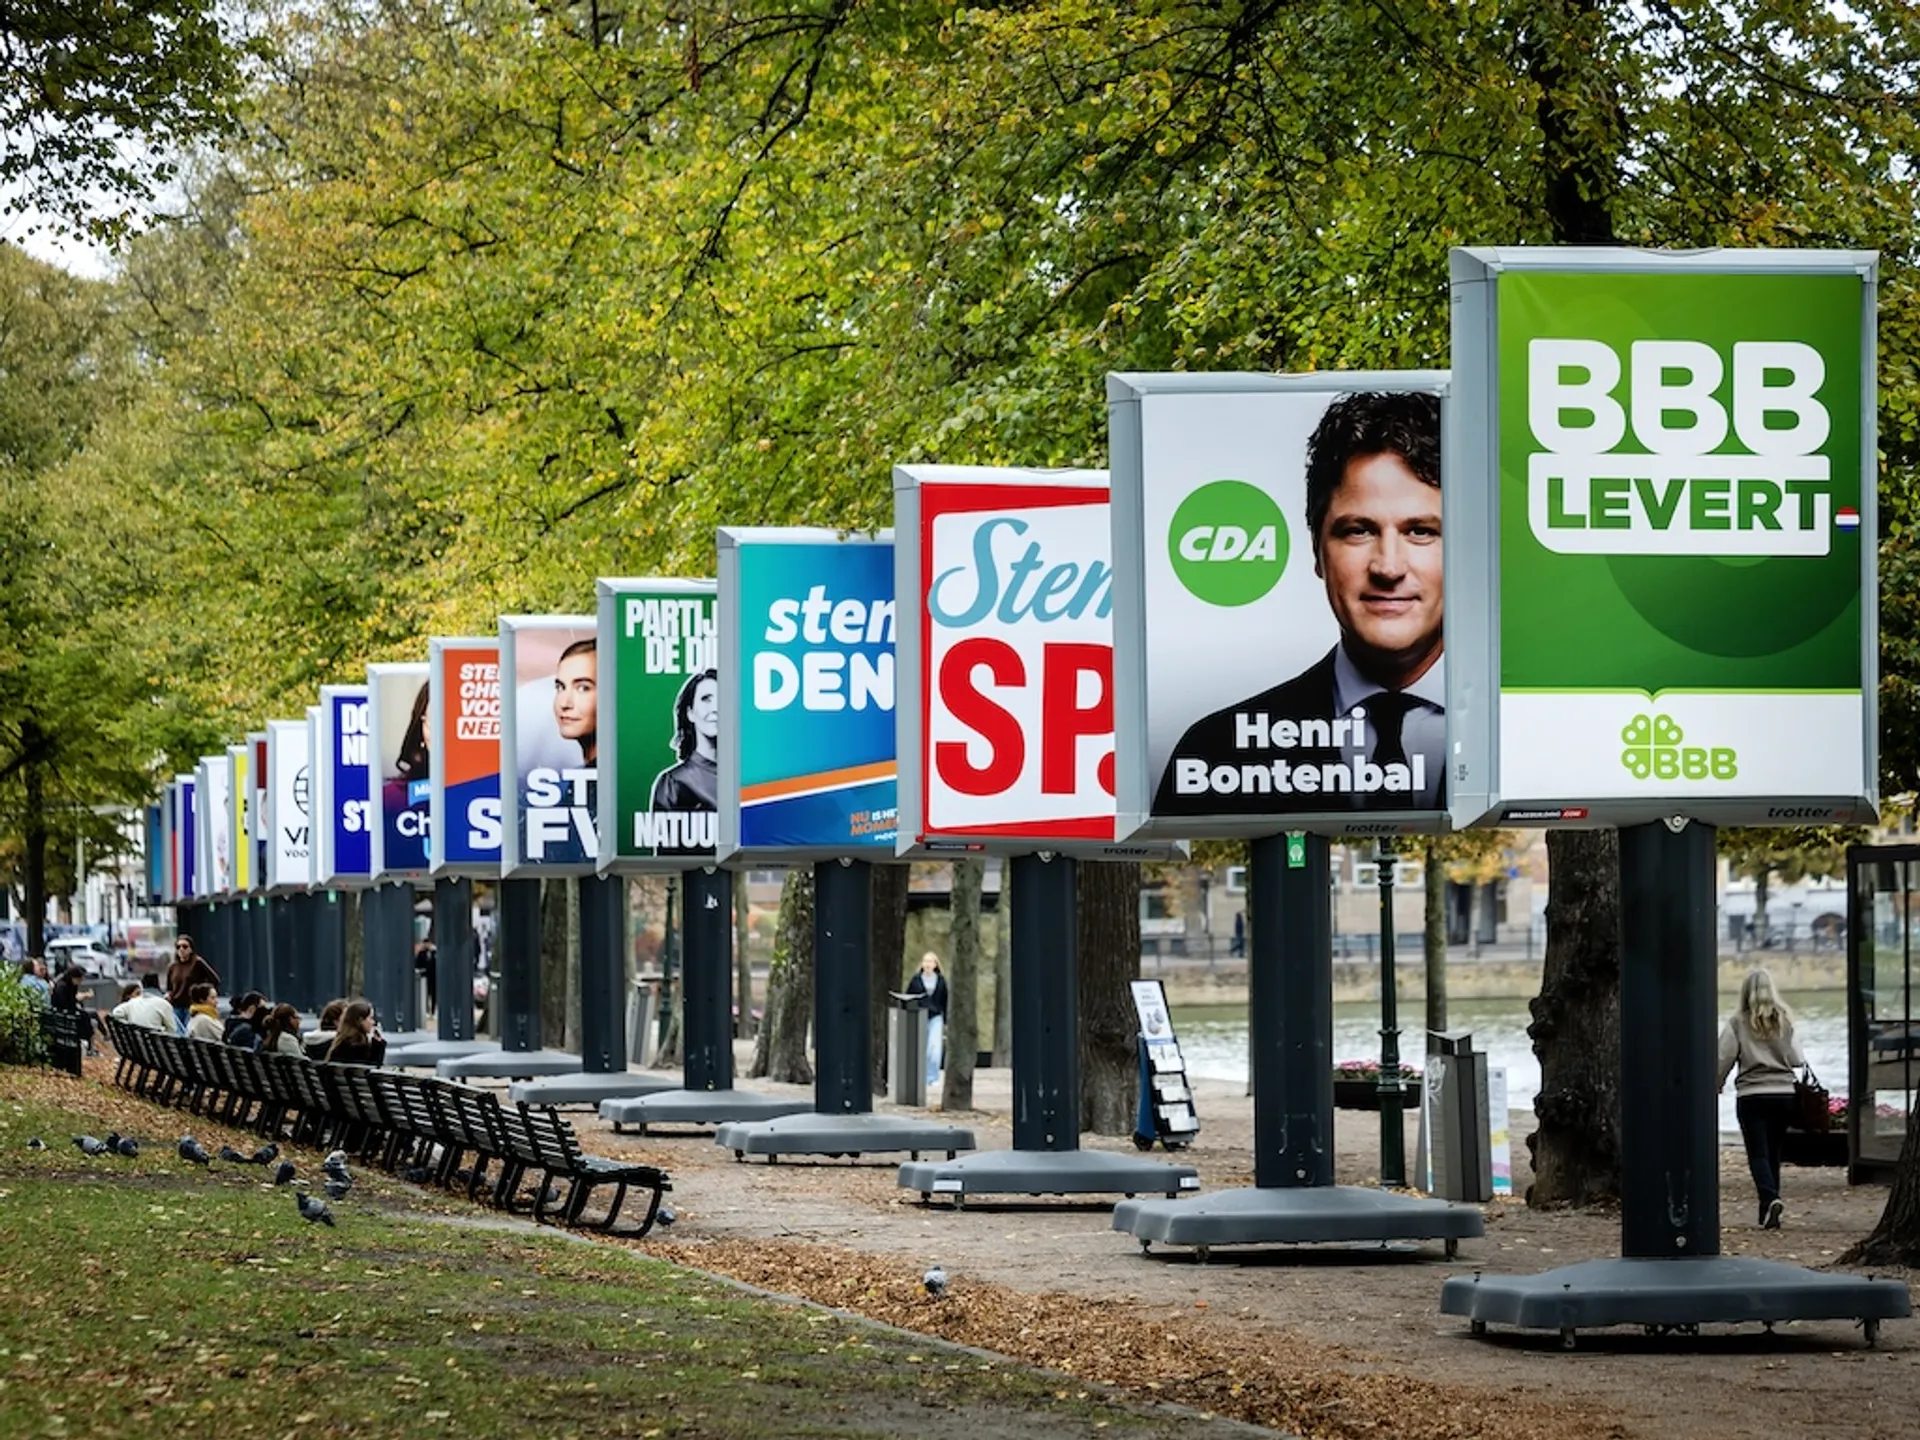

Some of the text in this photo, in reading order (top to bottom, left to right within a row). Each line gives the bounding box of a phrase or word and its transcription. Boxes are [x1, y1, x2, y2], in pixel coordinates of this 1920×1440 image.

[1528, 339, 1831, 456] BBB
[1547, 478, 1831, 530] LEVERT
[1178, 525, 1278, 562] CDA
[460, 663, 501, 680] STE
[645, 637, 680, 674] DE
[752, 652, 894, 711] DEN
[461, 720, 501, 736] NED
[1235, 707, 1365, 748] Henri
[1175, 754, 1426, 795] Bontenbal
[1653, 746, 1738, 780] BBB
[527, 768, 599, 807] ST
[468, 797, 502, 851] S
[634, 812, 718, 847] NATUU
